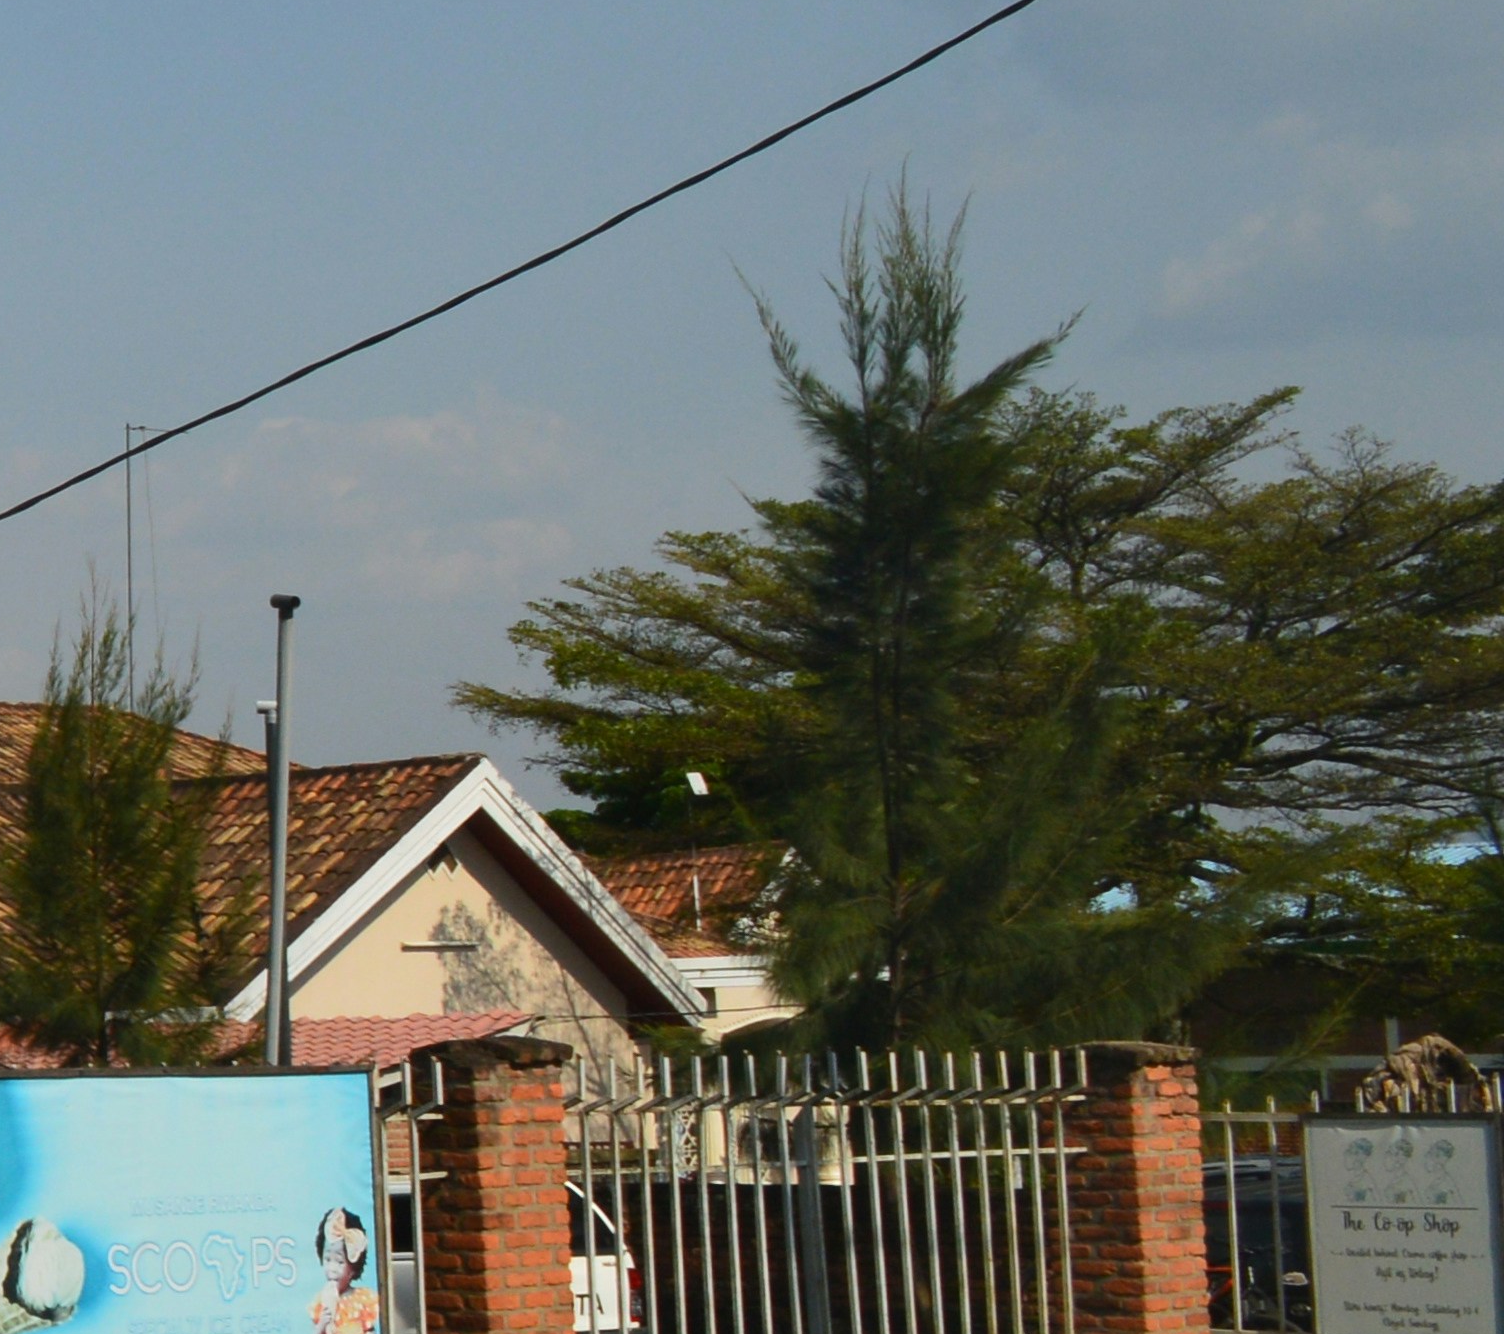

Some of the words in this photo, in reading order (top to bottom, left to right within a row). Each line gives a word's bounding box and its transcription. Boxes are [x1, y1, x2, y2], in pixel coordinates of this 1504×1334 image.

[1343, 1210, 1365, 1231] The
[1374, 1211, 1415, 1237] Co-op
[1423, 1212, 1461, 1238] Shop
